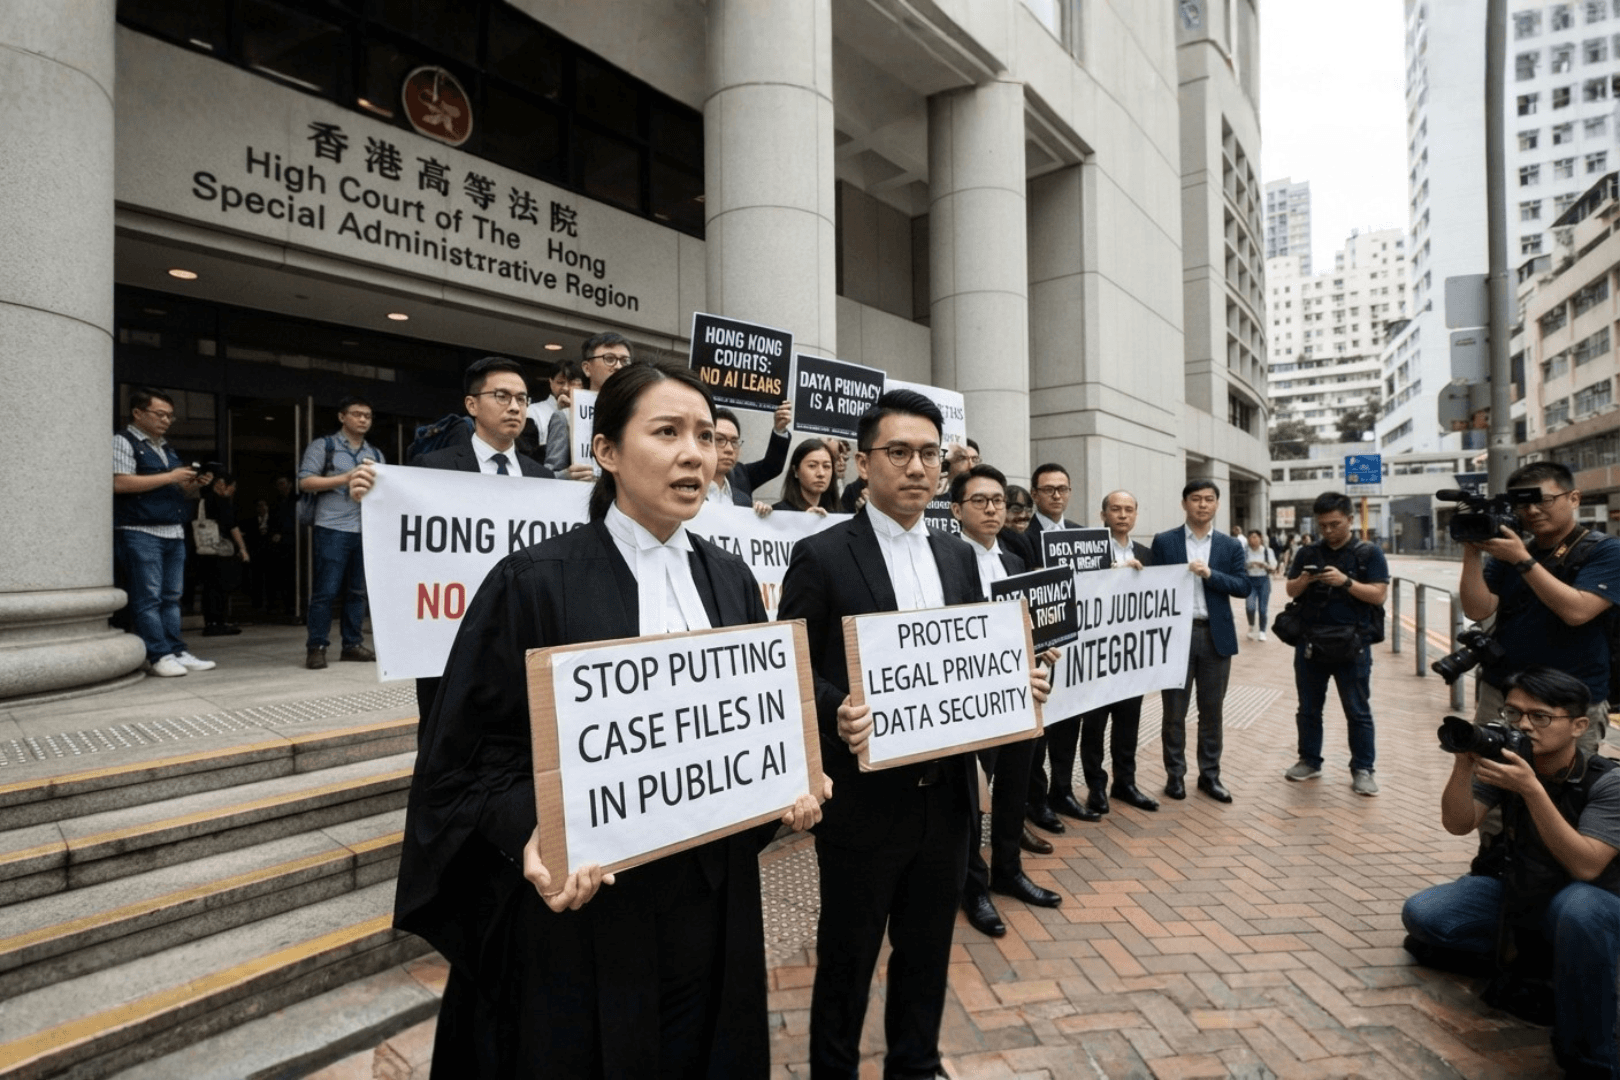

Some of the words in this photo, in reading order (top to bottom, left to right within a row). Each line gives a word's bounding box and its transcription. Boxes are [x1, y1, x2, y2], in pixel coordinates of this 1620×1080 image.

[306, 121, 578, 238] 香港高等法院
[246, 145, 326, 194] High
[339, 176, 425, 223] Court
[435, 209, 463, 233] of
[472, 214, 521, 249] The
[547, 237, 606, 279] Hong
[192, 170, 325, 231] Special
[566, 272, 639, 311] Region
[704, 325, 745, 349] HONG
[700, 366, 720, 386] NO
[723, 370, 738, 388] AI
[809, 392, 823, 410] IS
[825, 395, 834, 412] A
[400, 514, 495, 554] HONG
[750, 539, 795, 567] PRIV
[417, 582, 466, 620] NO
[1107, 588, 1181, 626] JUDICIAL
[897, 615, 989, 649] PROTECT
[573, 656, 659, 703] STOP
[669, 639, 786, 687] PUTTING
[868, 661, 939, 695] LEGAL
[943, 649, 1022, 684] PRIVACY
[1066, 626, 1172, 688] INTEGRITY
[578, 712, 666, 763] CASE
[675, 696, 751, 743] FILES
[758, 689, 785, 725] IN
[872, 703, 934, 738] DATA
[939, 686, 1027, 725] SECURITY
[589, 781, 627, 828] IN
[638, 750, 753, 814] PUBLIC
[761, 741, 787, 780] AI
